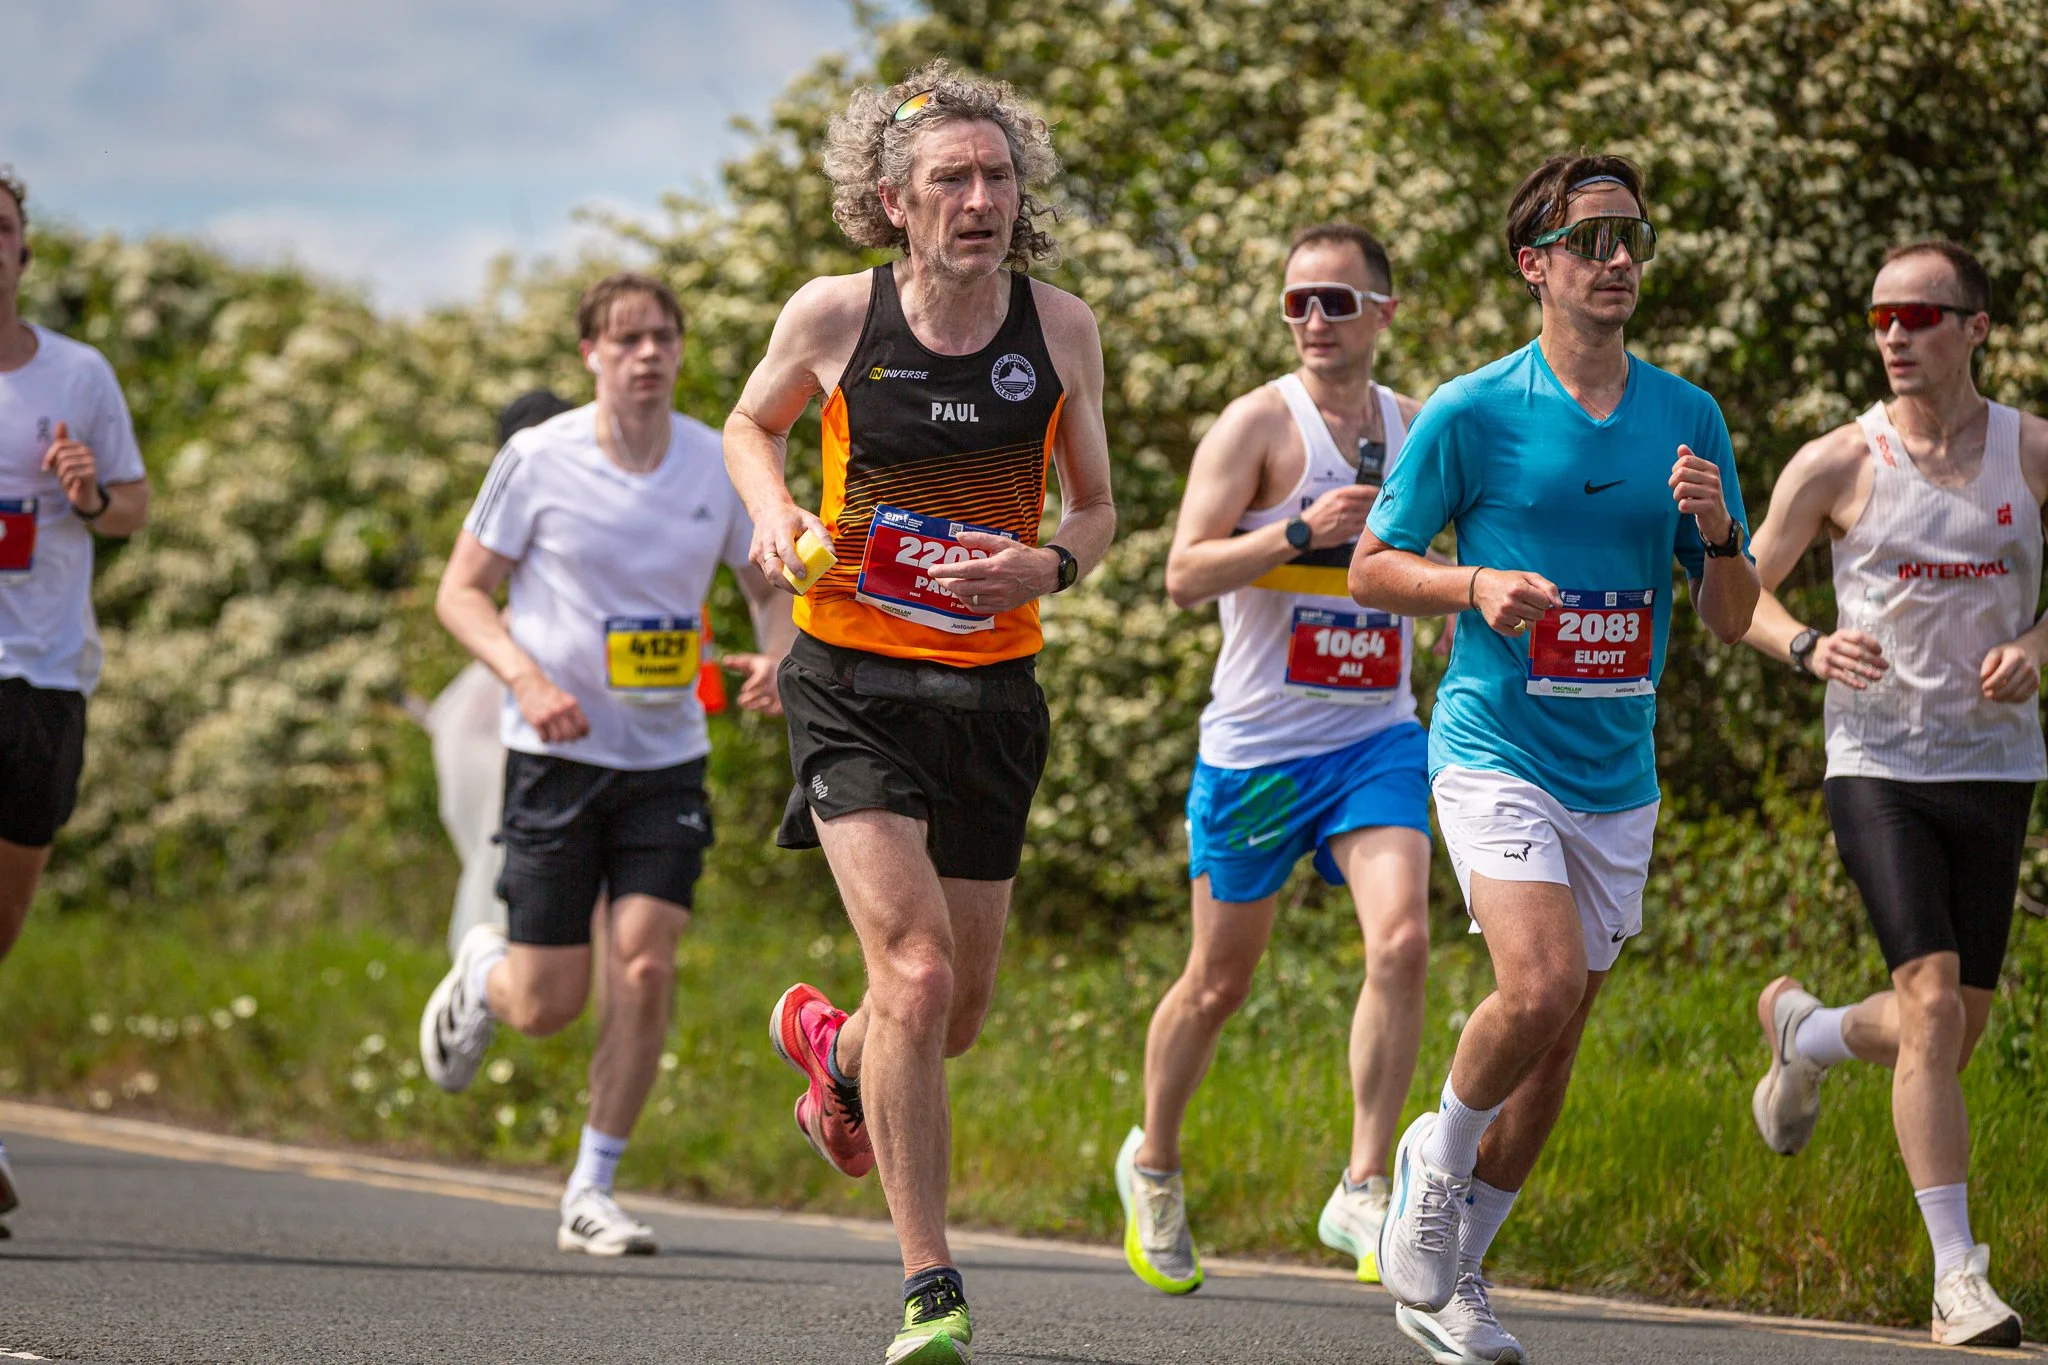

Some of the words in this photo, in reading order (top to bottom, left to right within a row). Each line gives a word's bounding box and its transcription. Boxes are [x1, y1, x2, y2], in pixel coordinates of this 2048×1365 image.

[883, 369, 929, 380] INVERSE
[993, 357, 1005, 375] BRAY
[1007, 354, 1034, 378] RUNNERS
[993, 377, 1018, 401] ATHLETIC
[1023, 380, 1034, 397] CLUB
[931, 402, 979, 422] PAUL
[1898, 560, 2009, 580] INTERVAL
[1557, 612, 1640, 643] 2083
[1314, 628, 1386, 659] 1064
[1574, 650, 1626, 665] ELIOTT
[1339, 661, 1363, 677] ALI
